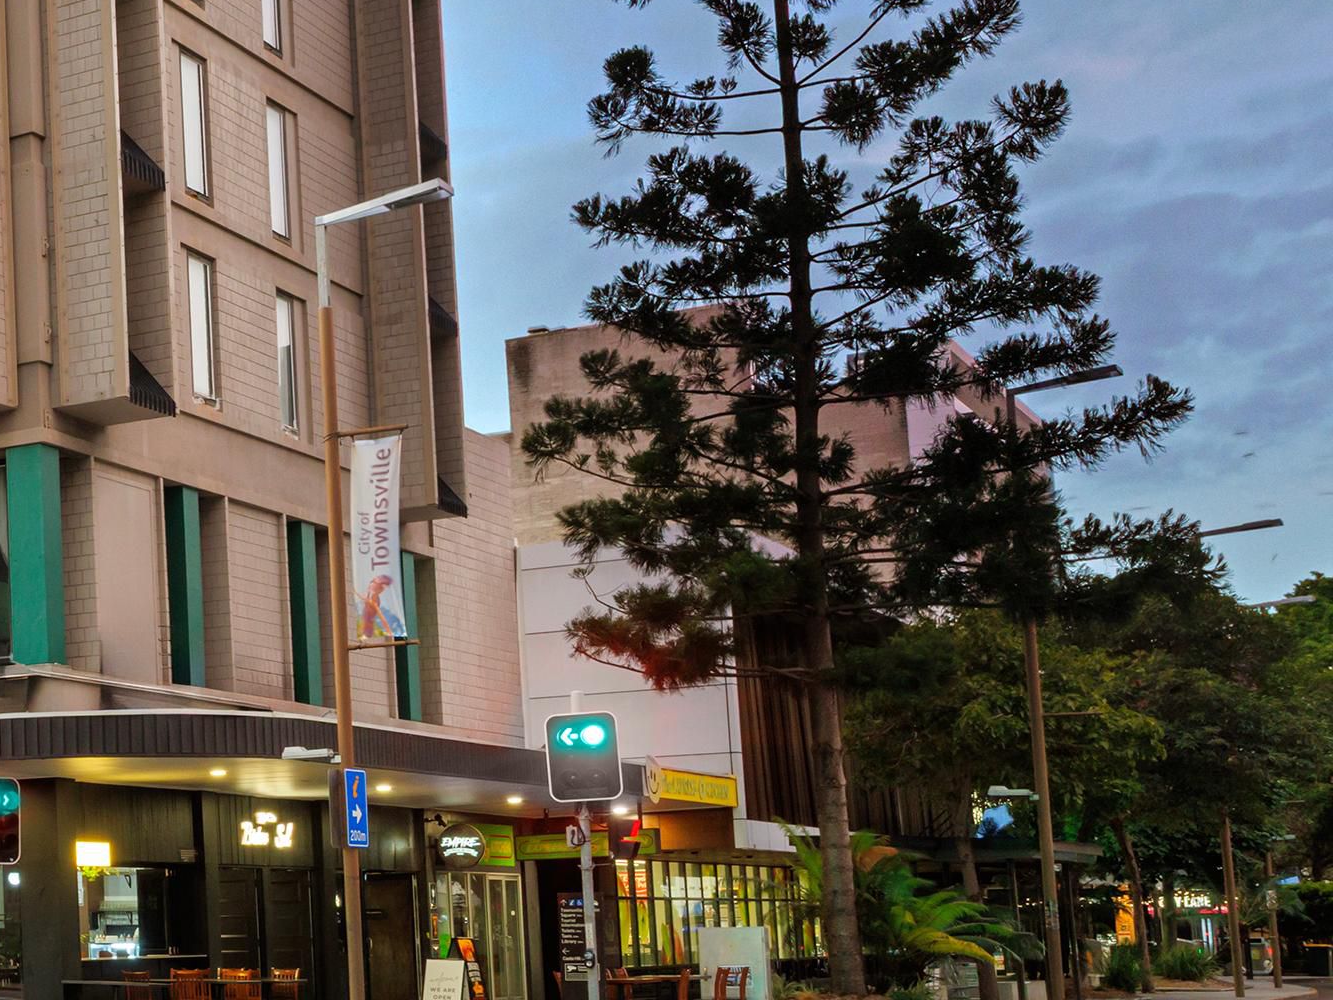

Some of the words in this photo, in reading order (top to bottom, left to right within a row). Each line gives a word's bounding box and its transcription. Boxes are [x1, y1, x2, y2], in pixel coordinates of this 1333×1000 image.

[370, 448, 392, 571] Townsville
[358, 511, 371, 525] of
[358, 528, 372, 555] City
[350, 829, 367, 842] 200m
[440, 836, 482, 849] EMPIRE
